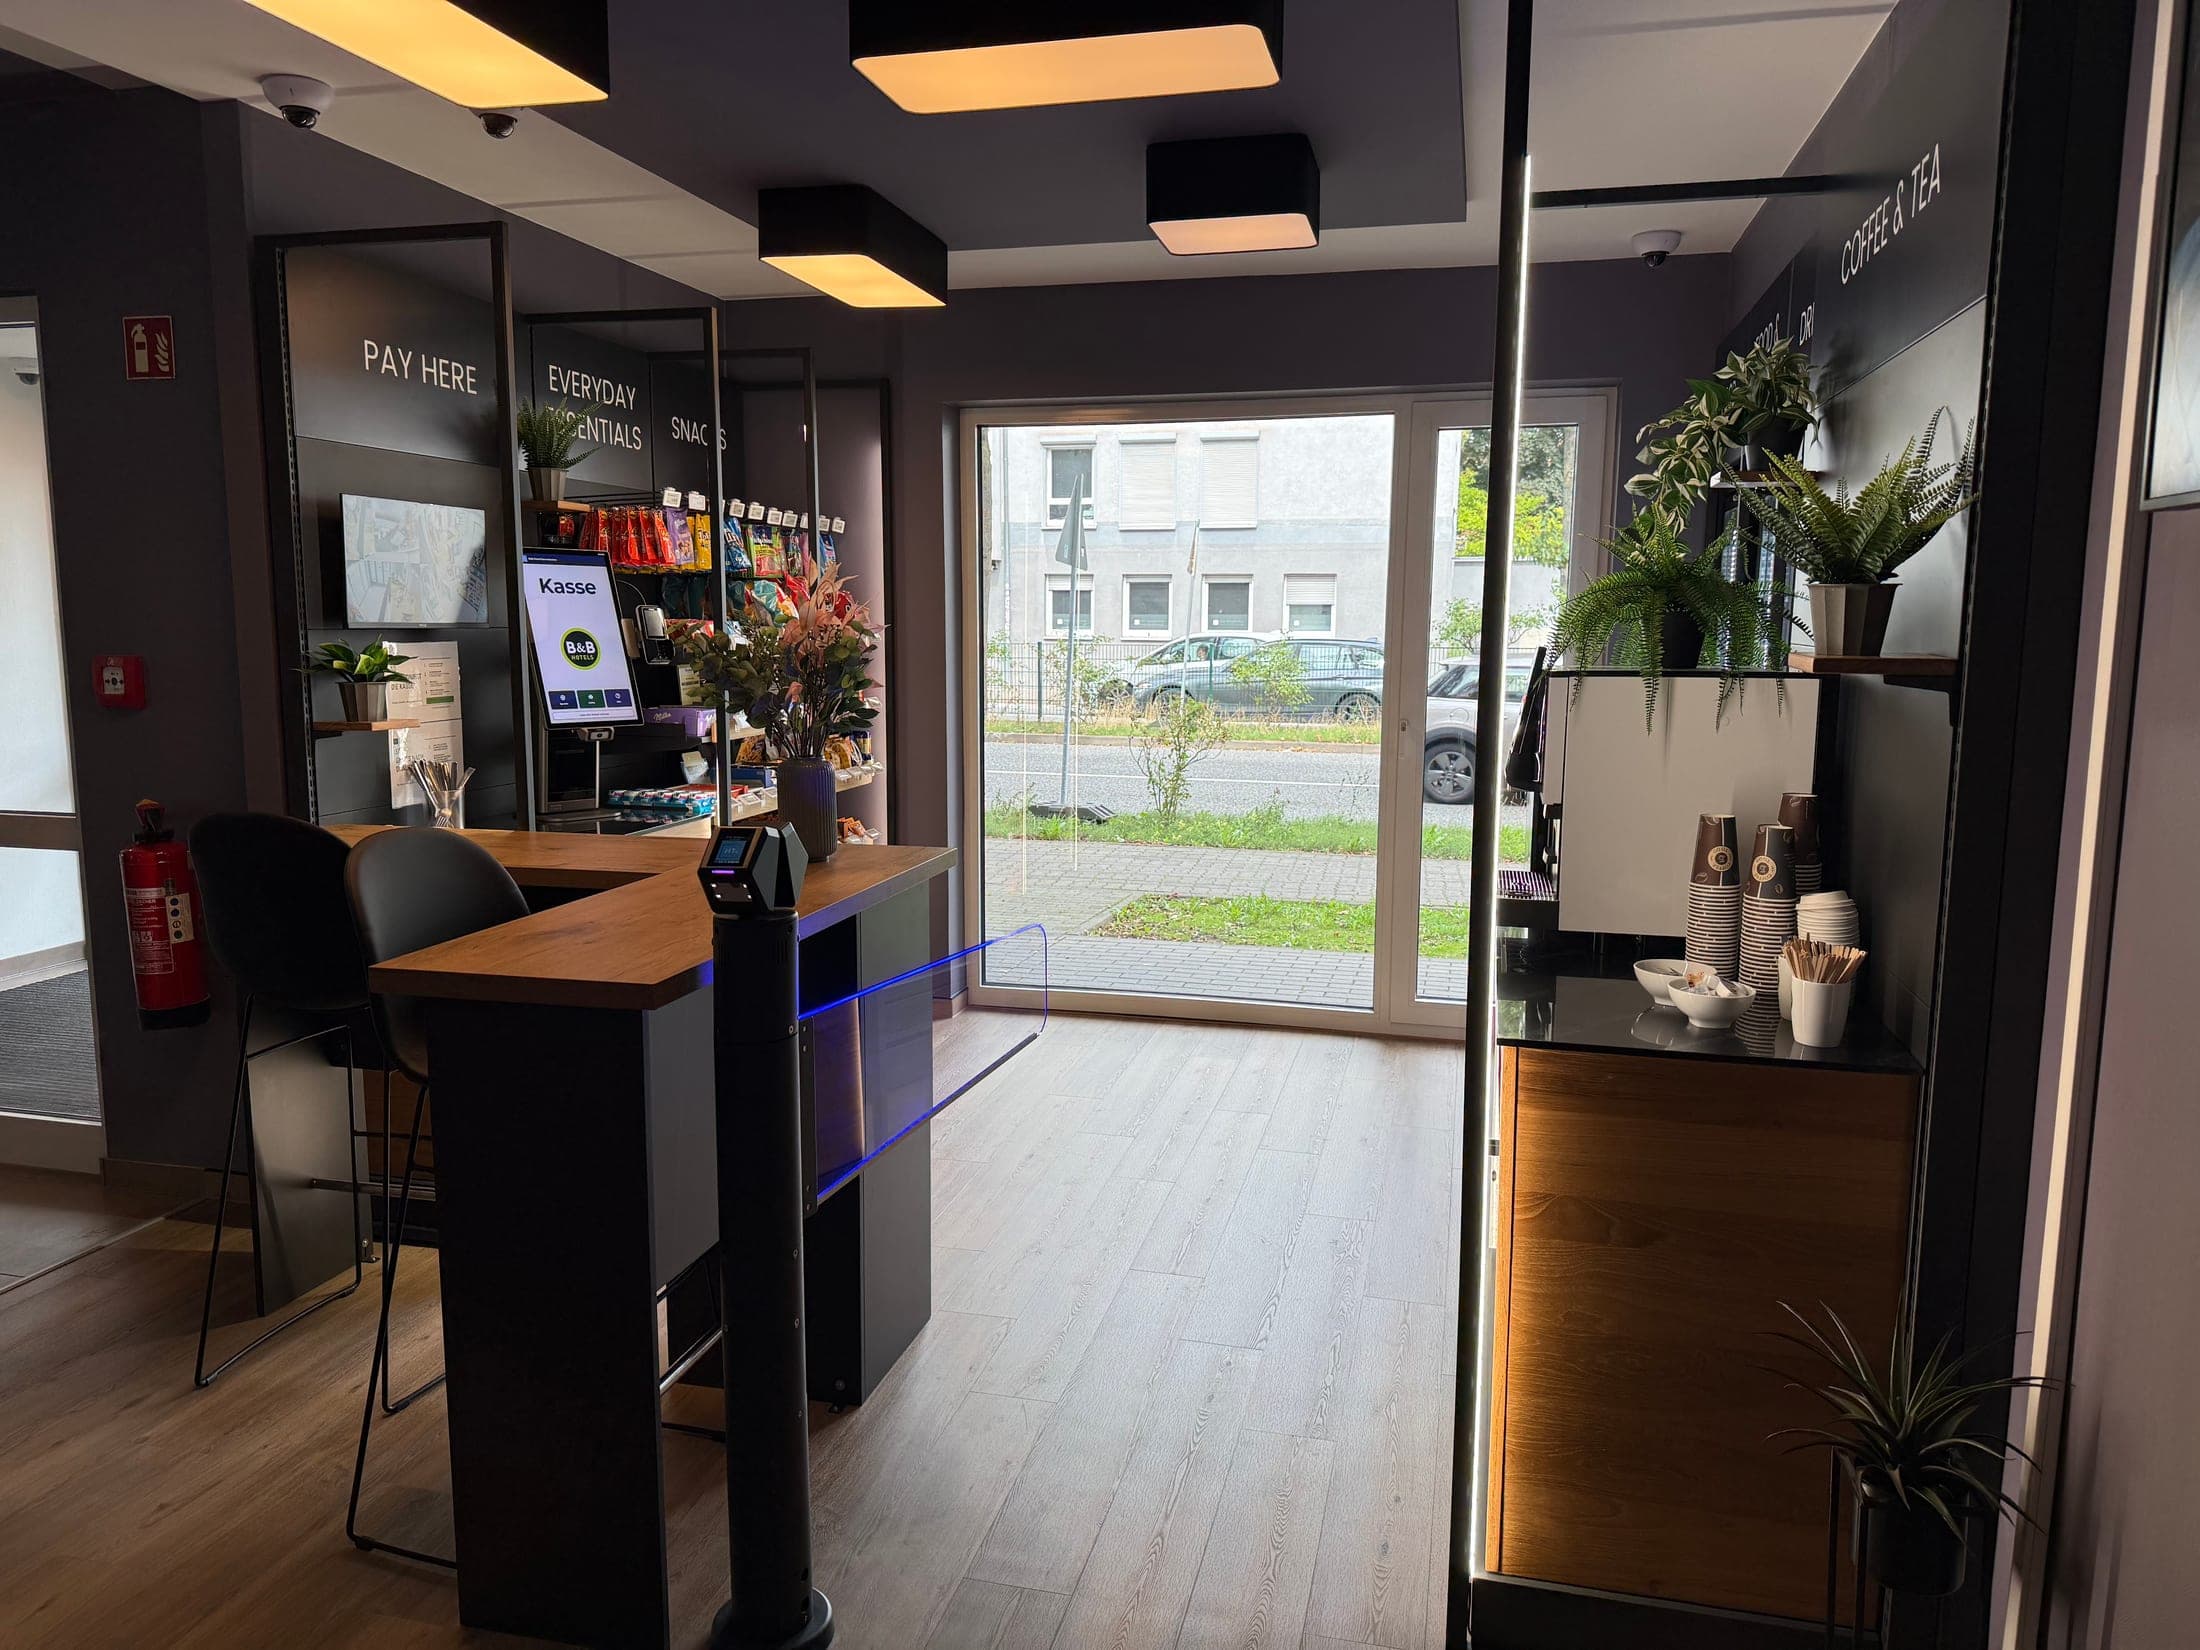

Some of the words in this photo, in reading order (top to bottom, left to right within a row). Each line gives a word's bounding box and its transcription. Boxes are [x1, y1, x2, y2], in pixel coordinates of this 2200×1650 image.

[1841, 196, 1891, 285] COFFEE
[1893, 179, 1904, 235] &
[1911, 143, 1941, 218] TEA
[1756, 322, 1773, 353] OOD
[364, 339, 413, 379] PAY
[421, 353, 478, 395] HERE
[549, 364, 636, 411] EVERYDAY
[548, 406, 642, 450] SENTIALS
[671, 416, 727, 450] SNACS
[539, 578, 597, 595] Kasse
[566, 641, 596, 654] B&B
